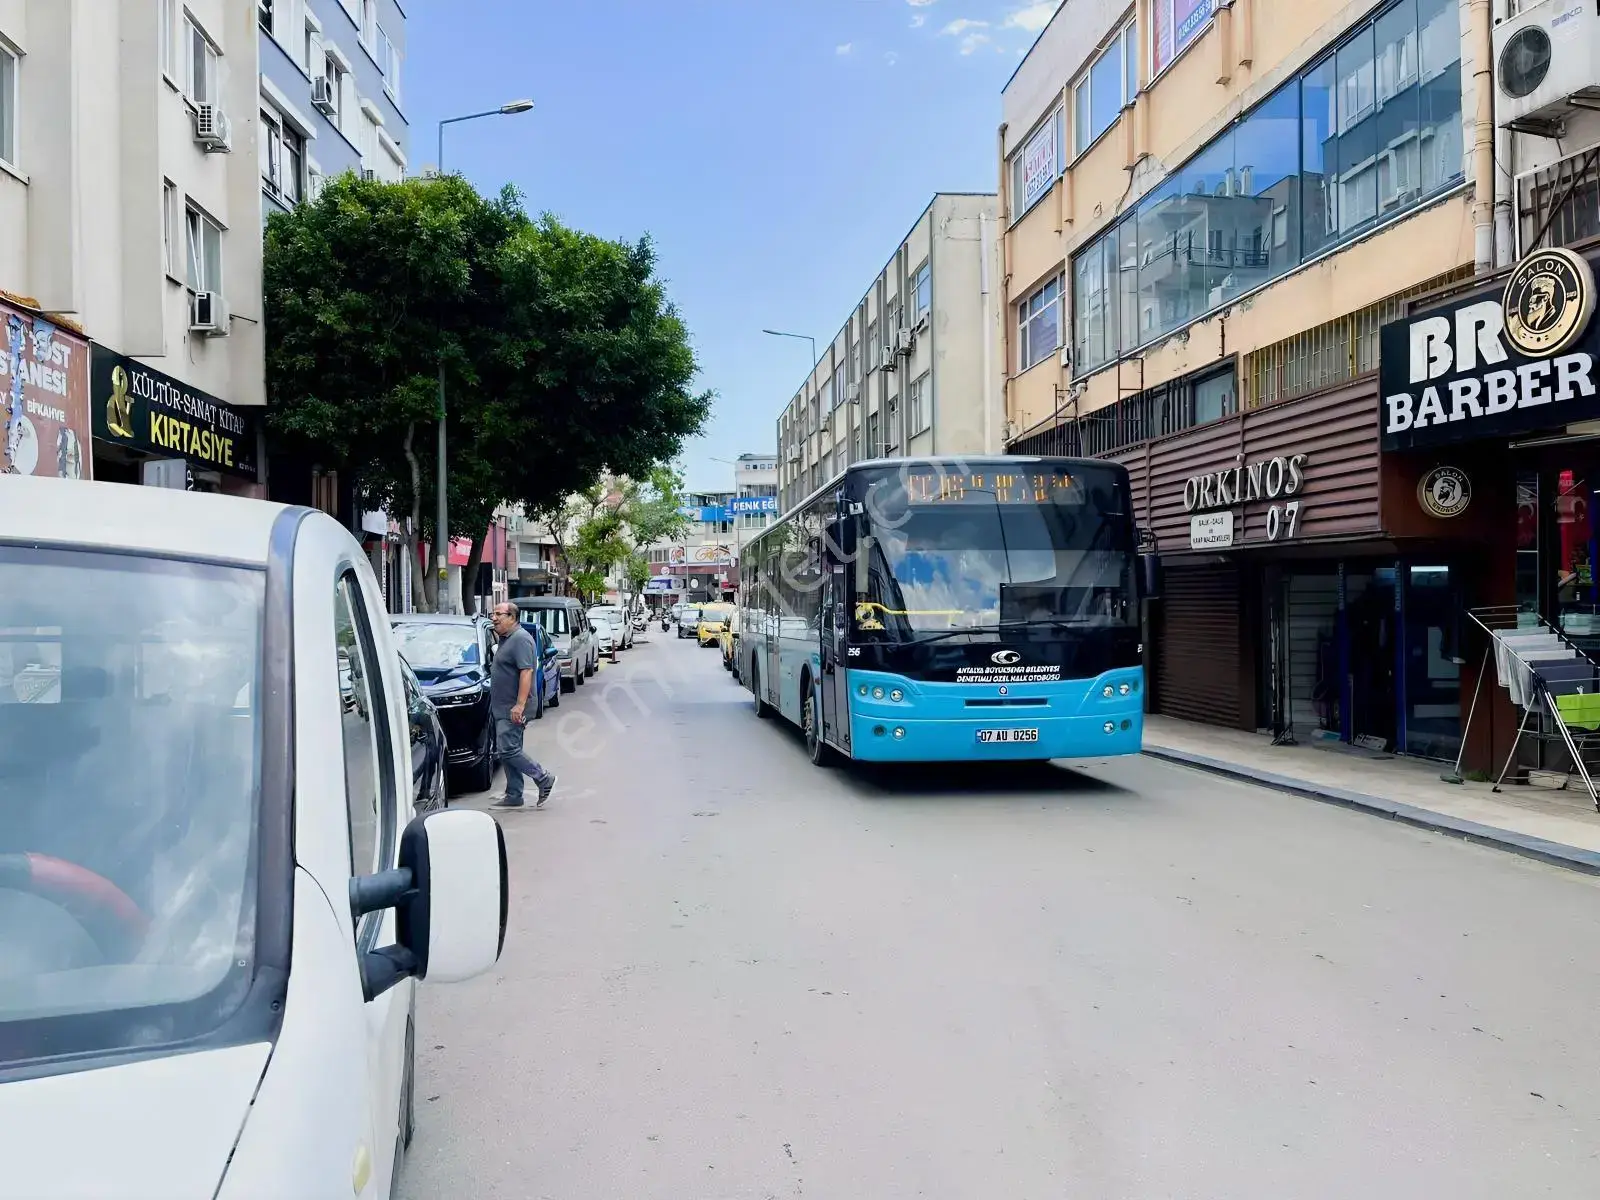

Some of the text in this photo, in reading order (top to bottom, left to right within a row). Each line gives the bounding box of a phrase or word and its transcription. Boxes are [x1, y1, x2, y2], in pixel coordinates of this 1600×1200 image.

[1518, 260, 1565, 287] SALON
[131, 370, 245, 435] KÜLTÜR-SANAT KİTAP
[1386, 352, 1596, 434] BARBER
[150, 410, 233, 467] KIRTASİYE
[1266, 500, 1302, 541] 07
[980, 729, 1037, 742] 07 AU 0256
